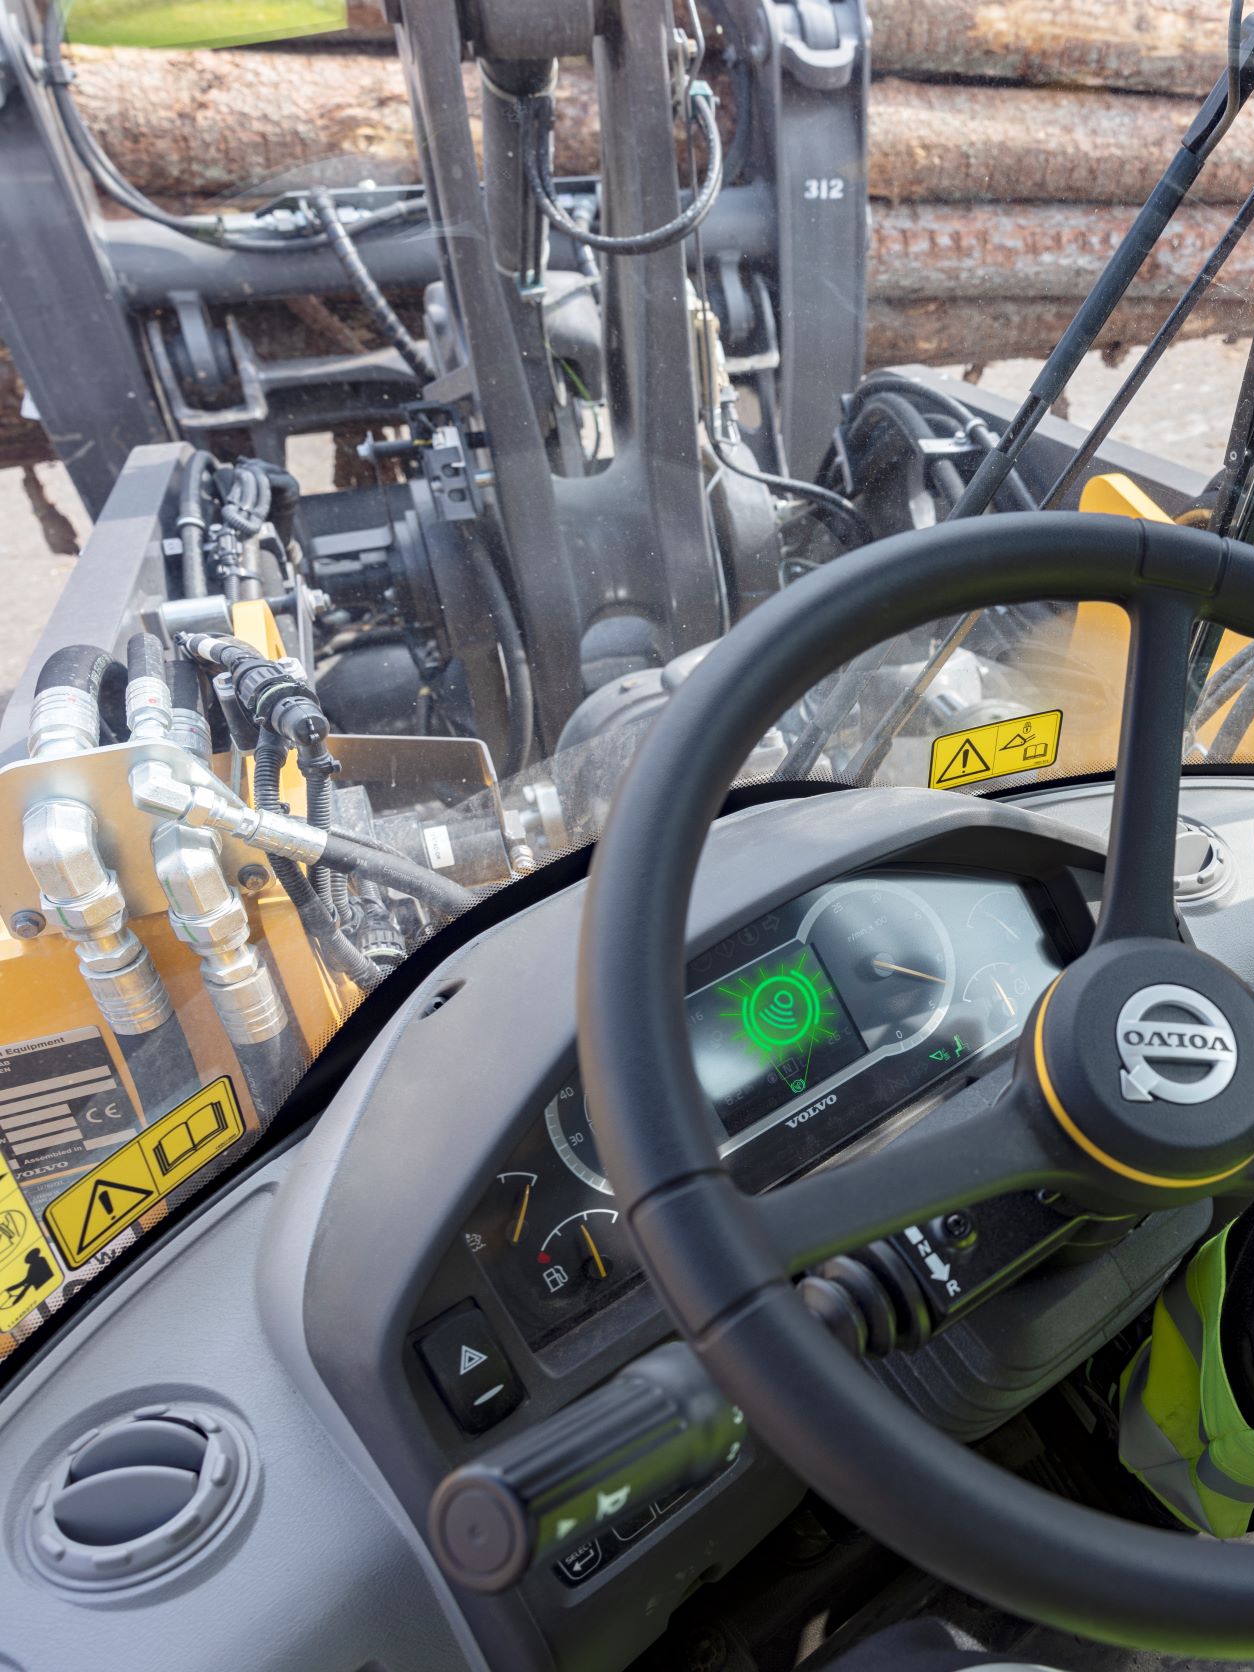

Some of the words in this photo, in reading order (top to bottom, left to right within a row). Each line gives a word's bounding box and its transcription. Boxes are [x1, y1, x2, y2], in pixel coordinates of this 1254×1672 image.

[804, 178, 844, 200] 312
[831, 902, 844, 914] 25
[895, 1030, 903, 1040] 0
[1123, 1030, 1233, 1053] VOLVO
[5, 1036, 66, 1055] Equipment
[560, 1086, 574, 1100] 40
[785, 1094, 838, 1129] VOLVO
[569, 1132, 584, 1147] 30
[24, 1148, 72, 1165] Assembled
[917, 1239, 932, 1258] N
[945, 1279, 961, 1297] R
